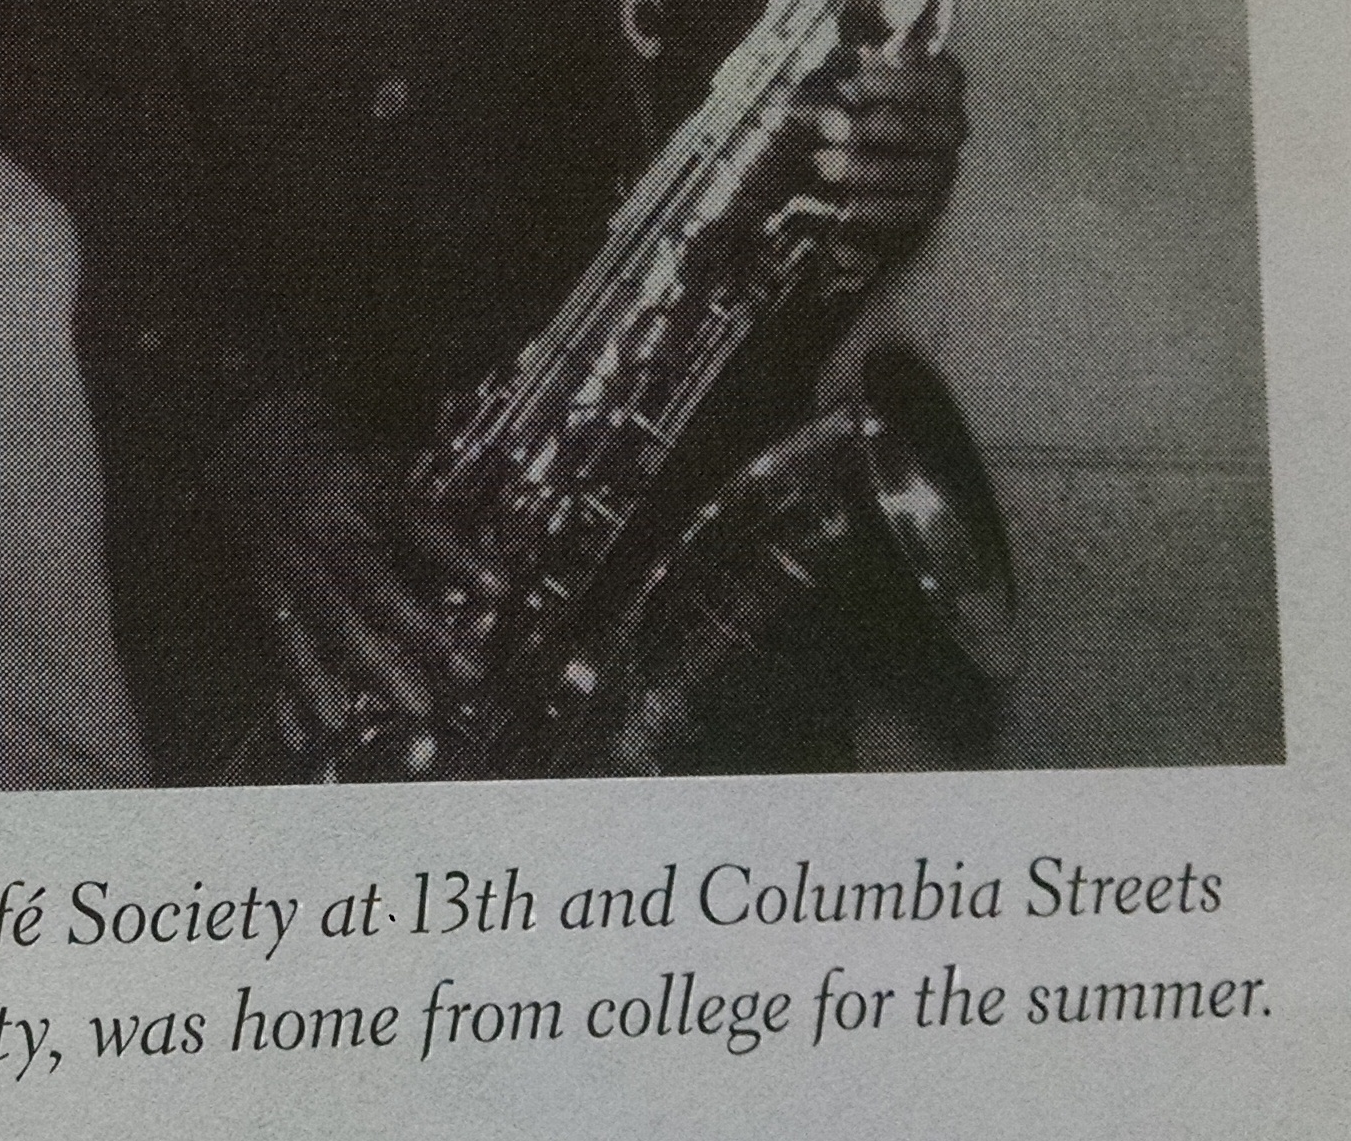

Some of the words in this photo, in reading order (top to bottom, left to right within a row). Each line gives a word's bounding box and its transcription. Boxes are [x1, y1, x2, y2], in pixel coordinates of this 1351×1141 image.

[66, 879, 300, 963] Society
[319, 881, 384, 939] at
[408, 865, 538, 936] 13th
[558, 861, 678, 931] and
[698, 855, 1004, 927] Columbia
[1025, 854, 1224, 919] Streets
[87, 1011, 207, 1059] was
[230, 984, 401, 1053] home
[418, 977, 565, 1064] from
[585, 970, 793, 1058] college
[811, 965, 897, 1049] for
[913, 962, 1007, 1030] the
[1025, 977, 1272, 1026] summer.
